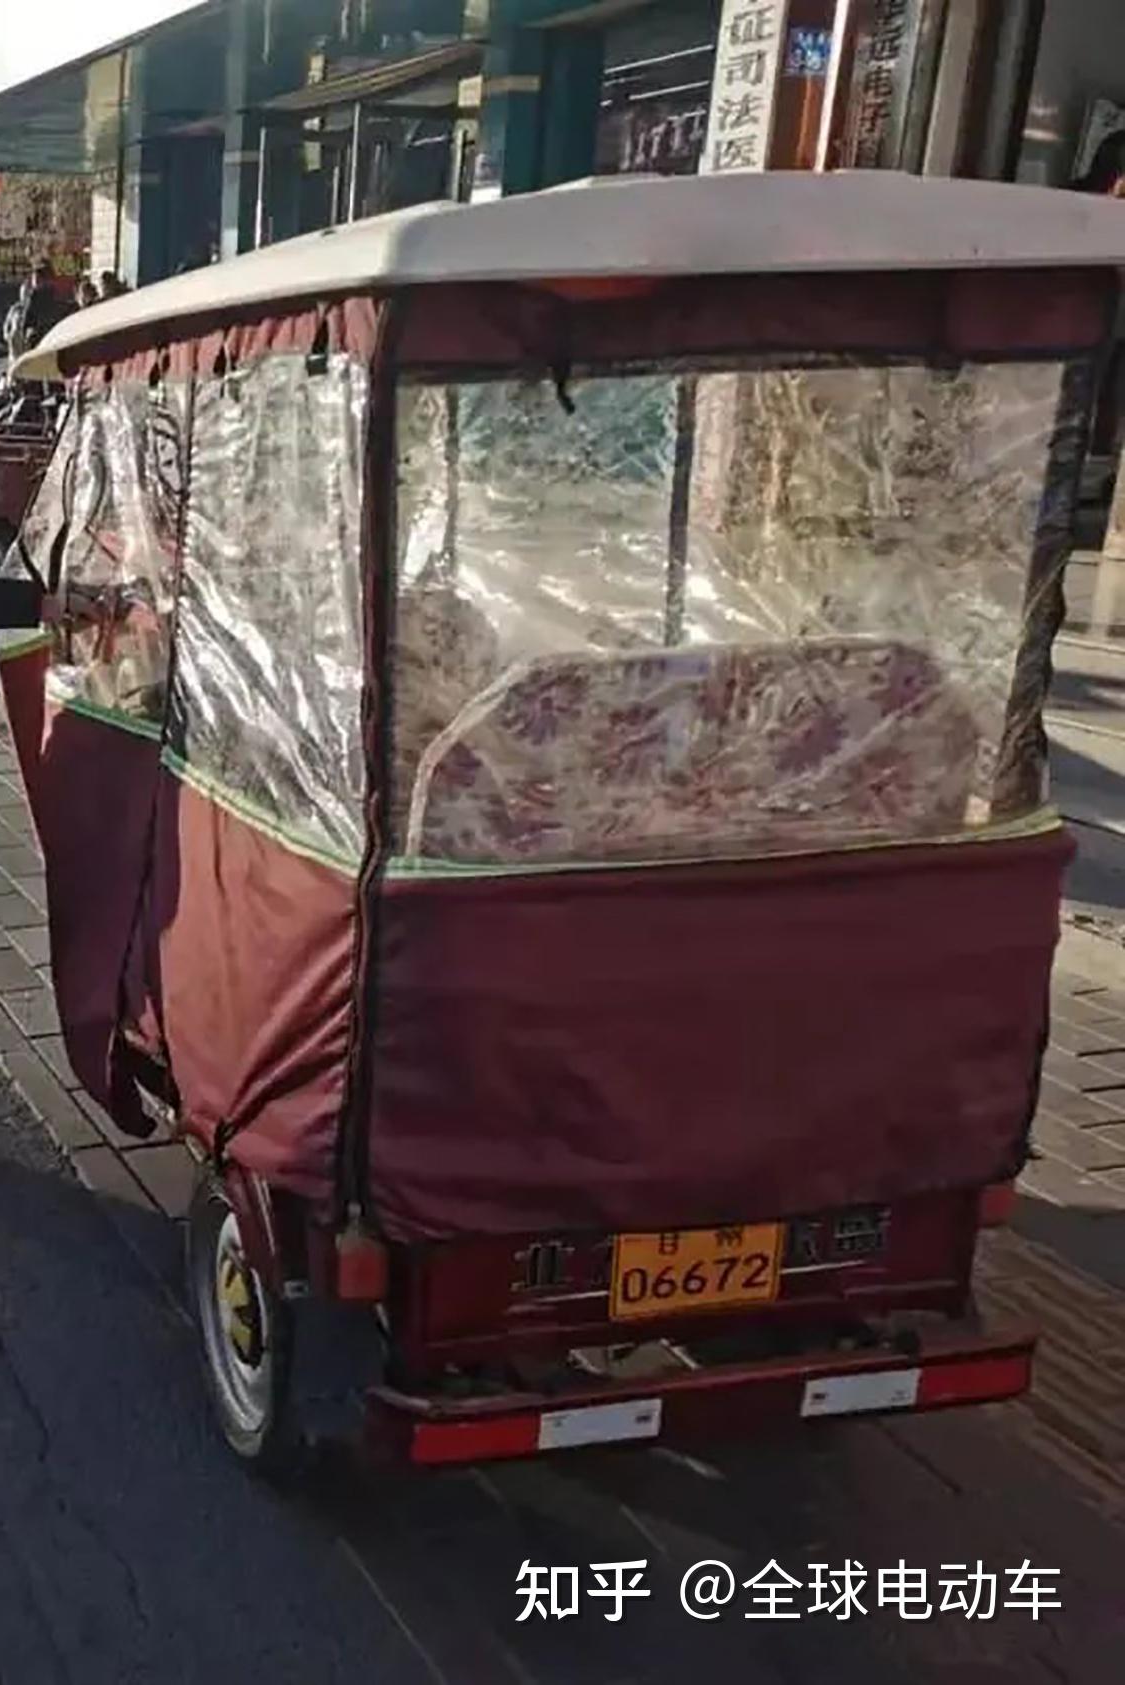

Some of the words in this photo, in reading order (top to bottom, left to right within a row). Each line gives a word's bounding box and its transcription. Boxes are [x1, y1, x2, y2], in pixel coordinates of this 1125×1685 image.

[710, 0, 776, 169] 证司法医
[621, 1252, 771, 1303] 06672
